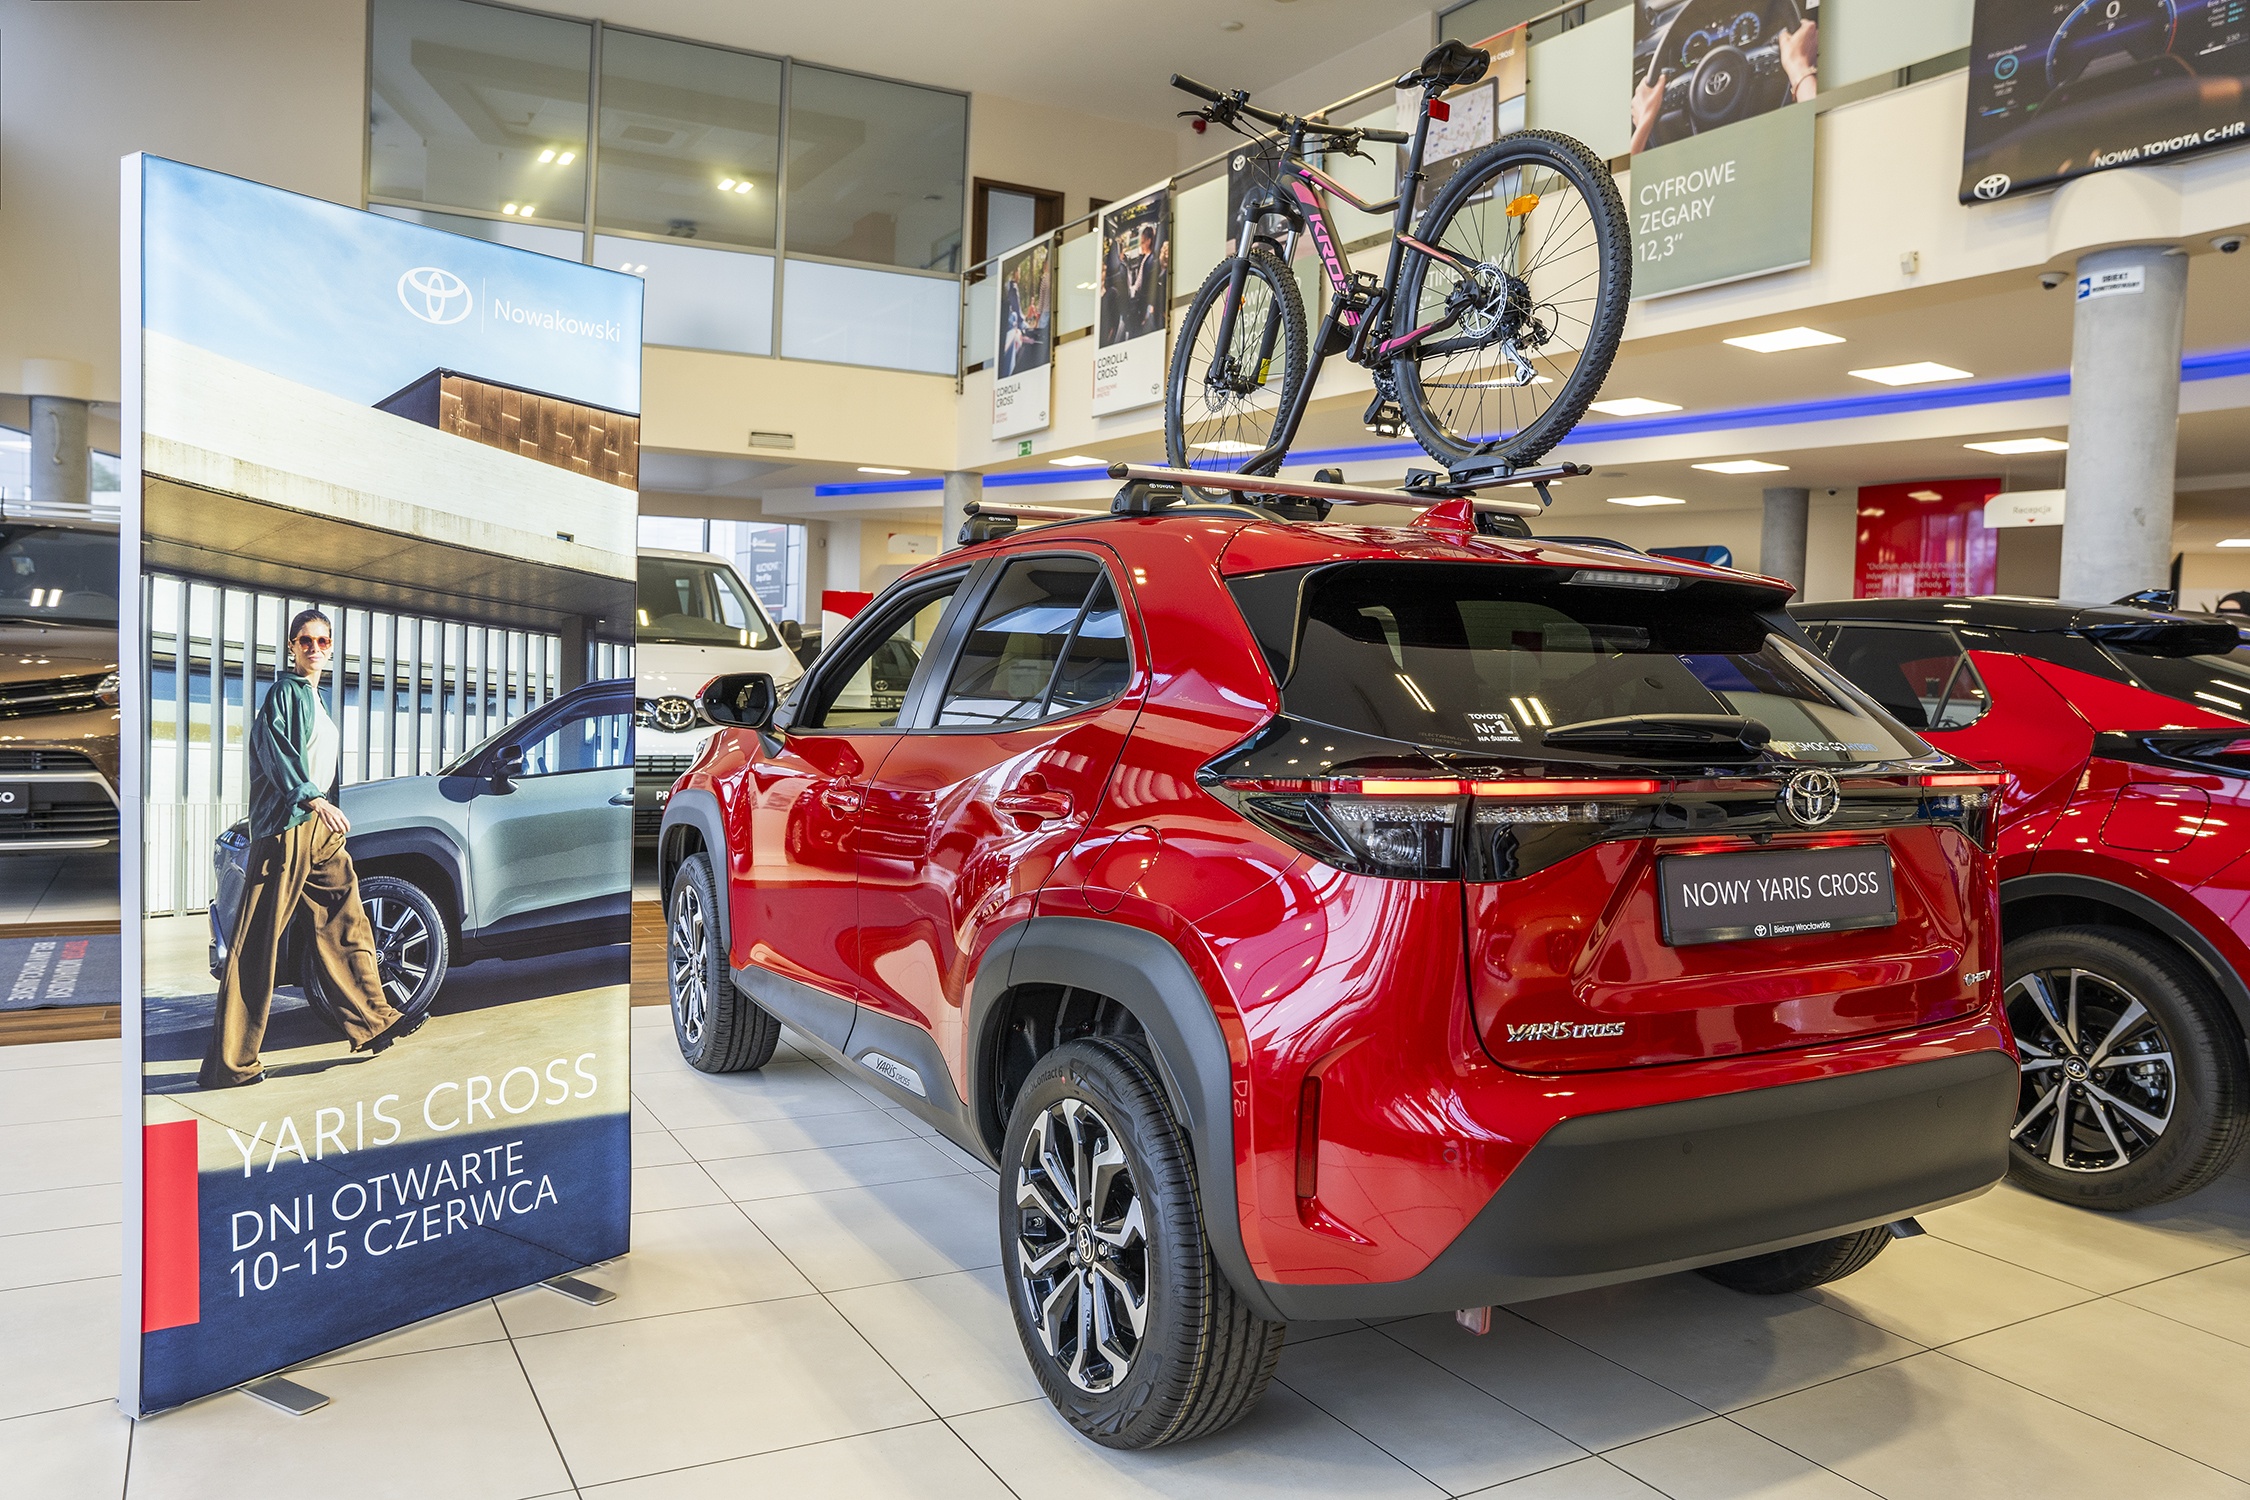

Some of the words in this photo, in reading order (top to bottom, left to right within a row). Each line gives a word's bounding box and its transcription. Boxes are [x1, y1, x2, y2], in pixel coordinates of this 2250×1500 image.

[2094, 147, 2140, 168] NOWA
[2143, 134, 2200, 157] TOYOTA
[2204, 121, 2246, 143] C-HR
[1549, 149, 1585, 181] KROSS
[1640, 160, 1736, 206] CYFROWE
[1639, 195, 1716, 235] ZEGARY
[494, 298, 621, 342] Nowakowski
[1096, 352, 1129, 369] COROLLA
[1096, 366, 1118, 381] CROSS
[996, 382, 1021, 398] COROLLA
[996, 396, 1014, 408] CROSS
[2013, 506, 2052, 516] Recepcja
[1796, 741, 1829, 752] SMOG
[1828, 741, 1847, 752] GO
[1683, 879, 1751, 908] NOWY
[1757, 876, 1812, 902] YARIS
[1818, 871, 1879, 898] CROSS
[1773, 923, 1795, 934] Bielany
[1795, 920, 1831, 932] Wrocławskie
[1971, 969, 1991, 983] HEV
[1506, 1021, 1574, 1042] YARIS
[1573, 1022, 1626, 1039] CROSS
[226, 1094, 402, 1179] YARIS
[423, 1053, 598, 1132] CROSS
[231, 1194, 314, 1253] DNI
[332, 1141, 524, 1221] OTWARTE
[230, 1230, 348, 1298] 10-15
[363, 1174, 558, 1257] CZERWCA
